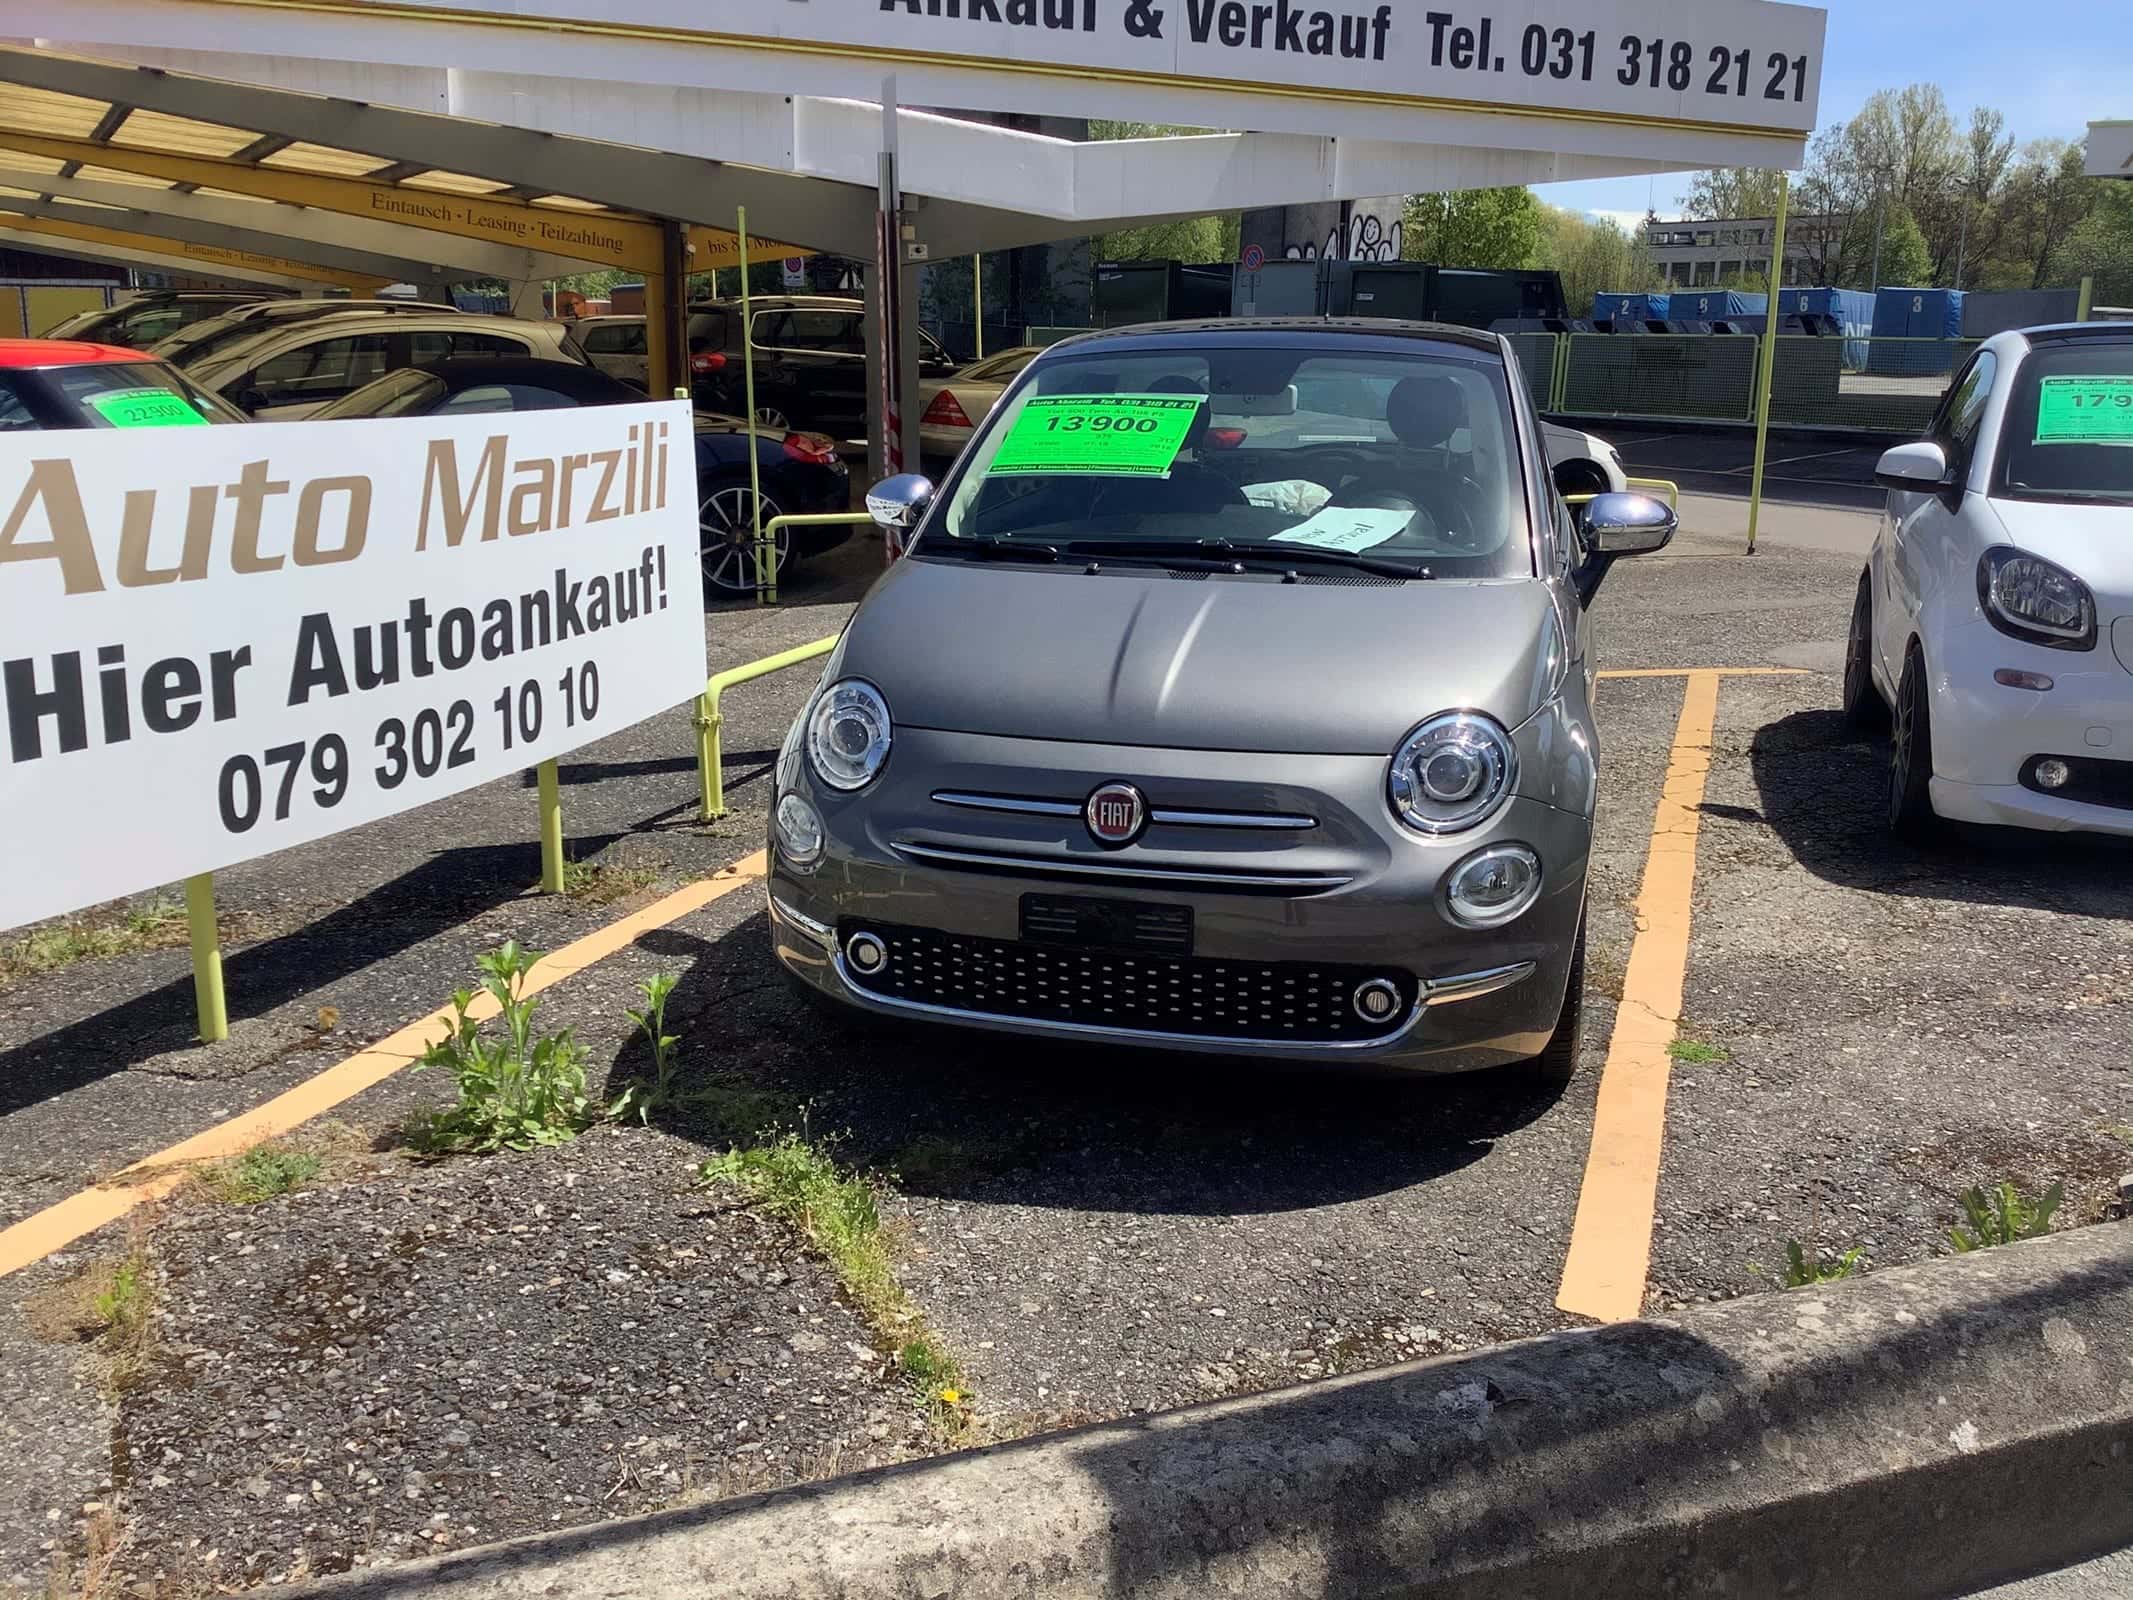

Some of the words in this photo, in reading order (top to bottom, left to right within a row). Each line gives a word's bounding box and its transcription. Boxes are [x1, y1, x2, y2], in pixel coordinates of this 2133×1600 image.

[879, 0, 1096, 32] auf
[1188, 0, 1391, 61] Verkauf
[1426, 11, 1504, 73] Tel.
[1520, 24, 1596, 81] 031
[1616, 35, 1692, 91] 318
[1705, 45, 1751, 97] 21
[1763, 52, 1808, 102] 21
[371, 192, 451, 221] Eintausch
[466, 209, 527, 237] Leasing
[537, 221, 624, 254] Teilzahlung
[708, 239, 728, 255] bis
[1621, 299, 1629, 315] 2
[1912, 295, 1922, 312] 3
[1047, 416, 1158, 433] 13'900
[0, 458, 373, 596] Auto
[414, 421, 670, 554] Marzili
[3, 644, 252, 763] Hier
[287, 544, 668, 707] Autoankauf!
[218, 733, 349, 835] 079
[374, 699, 476, 790] 302
[494, 679, 543, 751] 10
[558, 660, 600, 730] 10
[1100, 801, 1132, 828] FIAT
